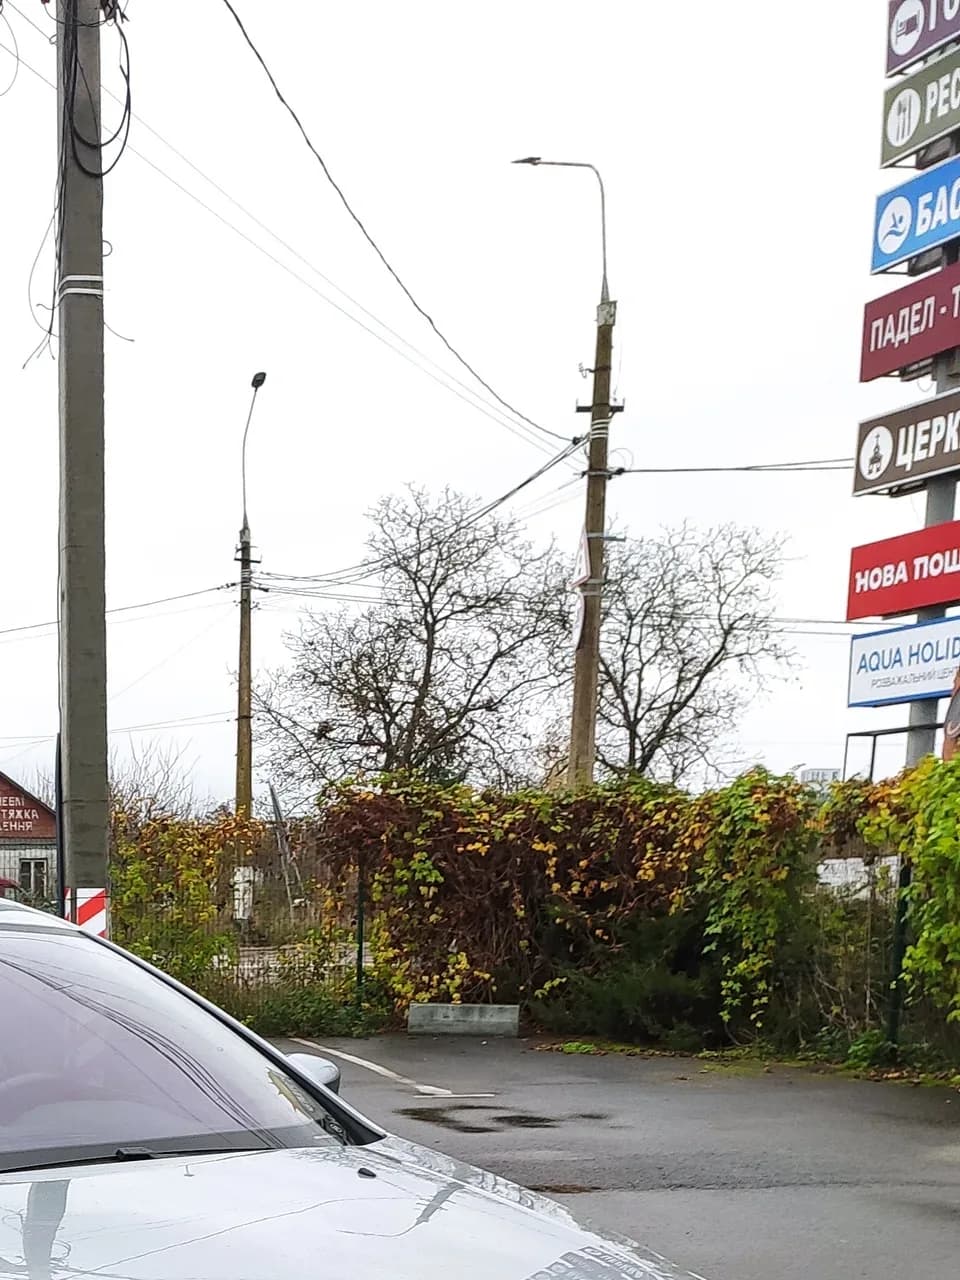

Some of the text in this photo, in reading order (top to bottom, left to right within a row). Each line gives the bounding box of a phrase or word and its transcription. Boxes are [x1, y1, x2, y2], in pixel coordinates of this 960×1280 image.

[915, 176, 960, 237] БАС
[870, 296, 936, 352] ПАДЕЛ
[895, 409, 960, 471] ЦЕРК
[855, 561, 908, 593] НОВА
[856, 647, 903, 675] AQUA
